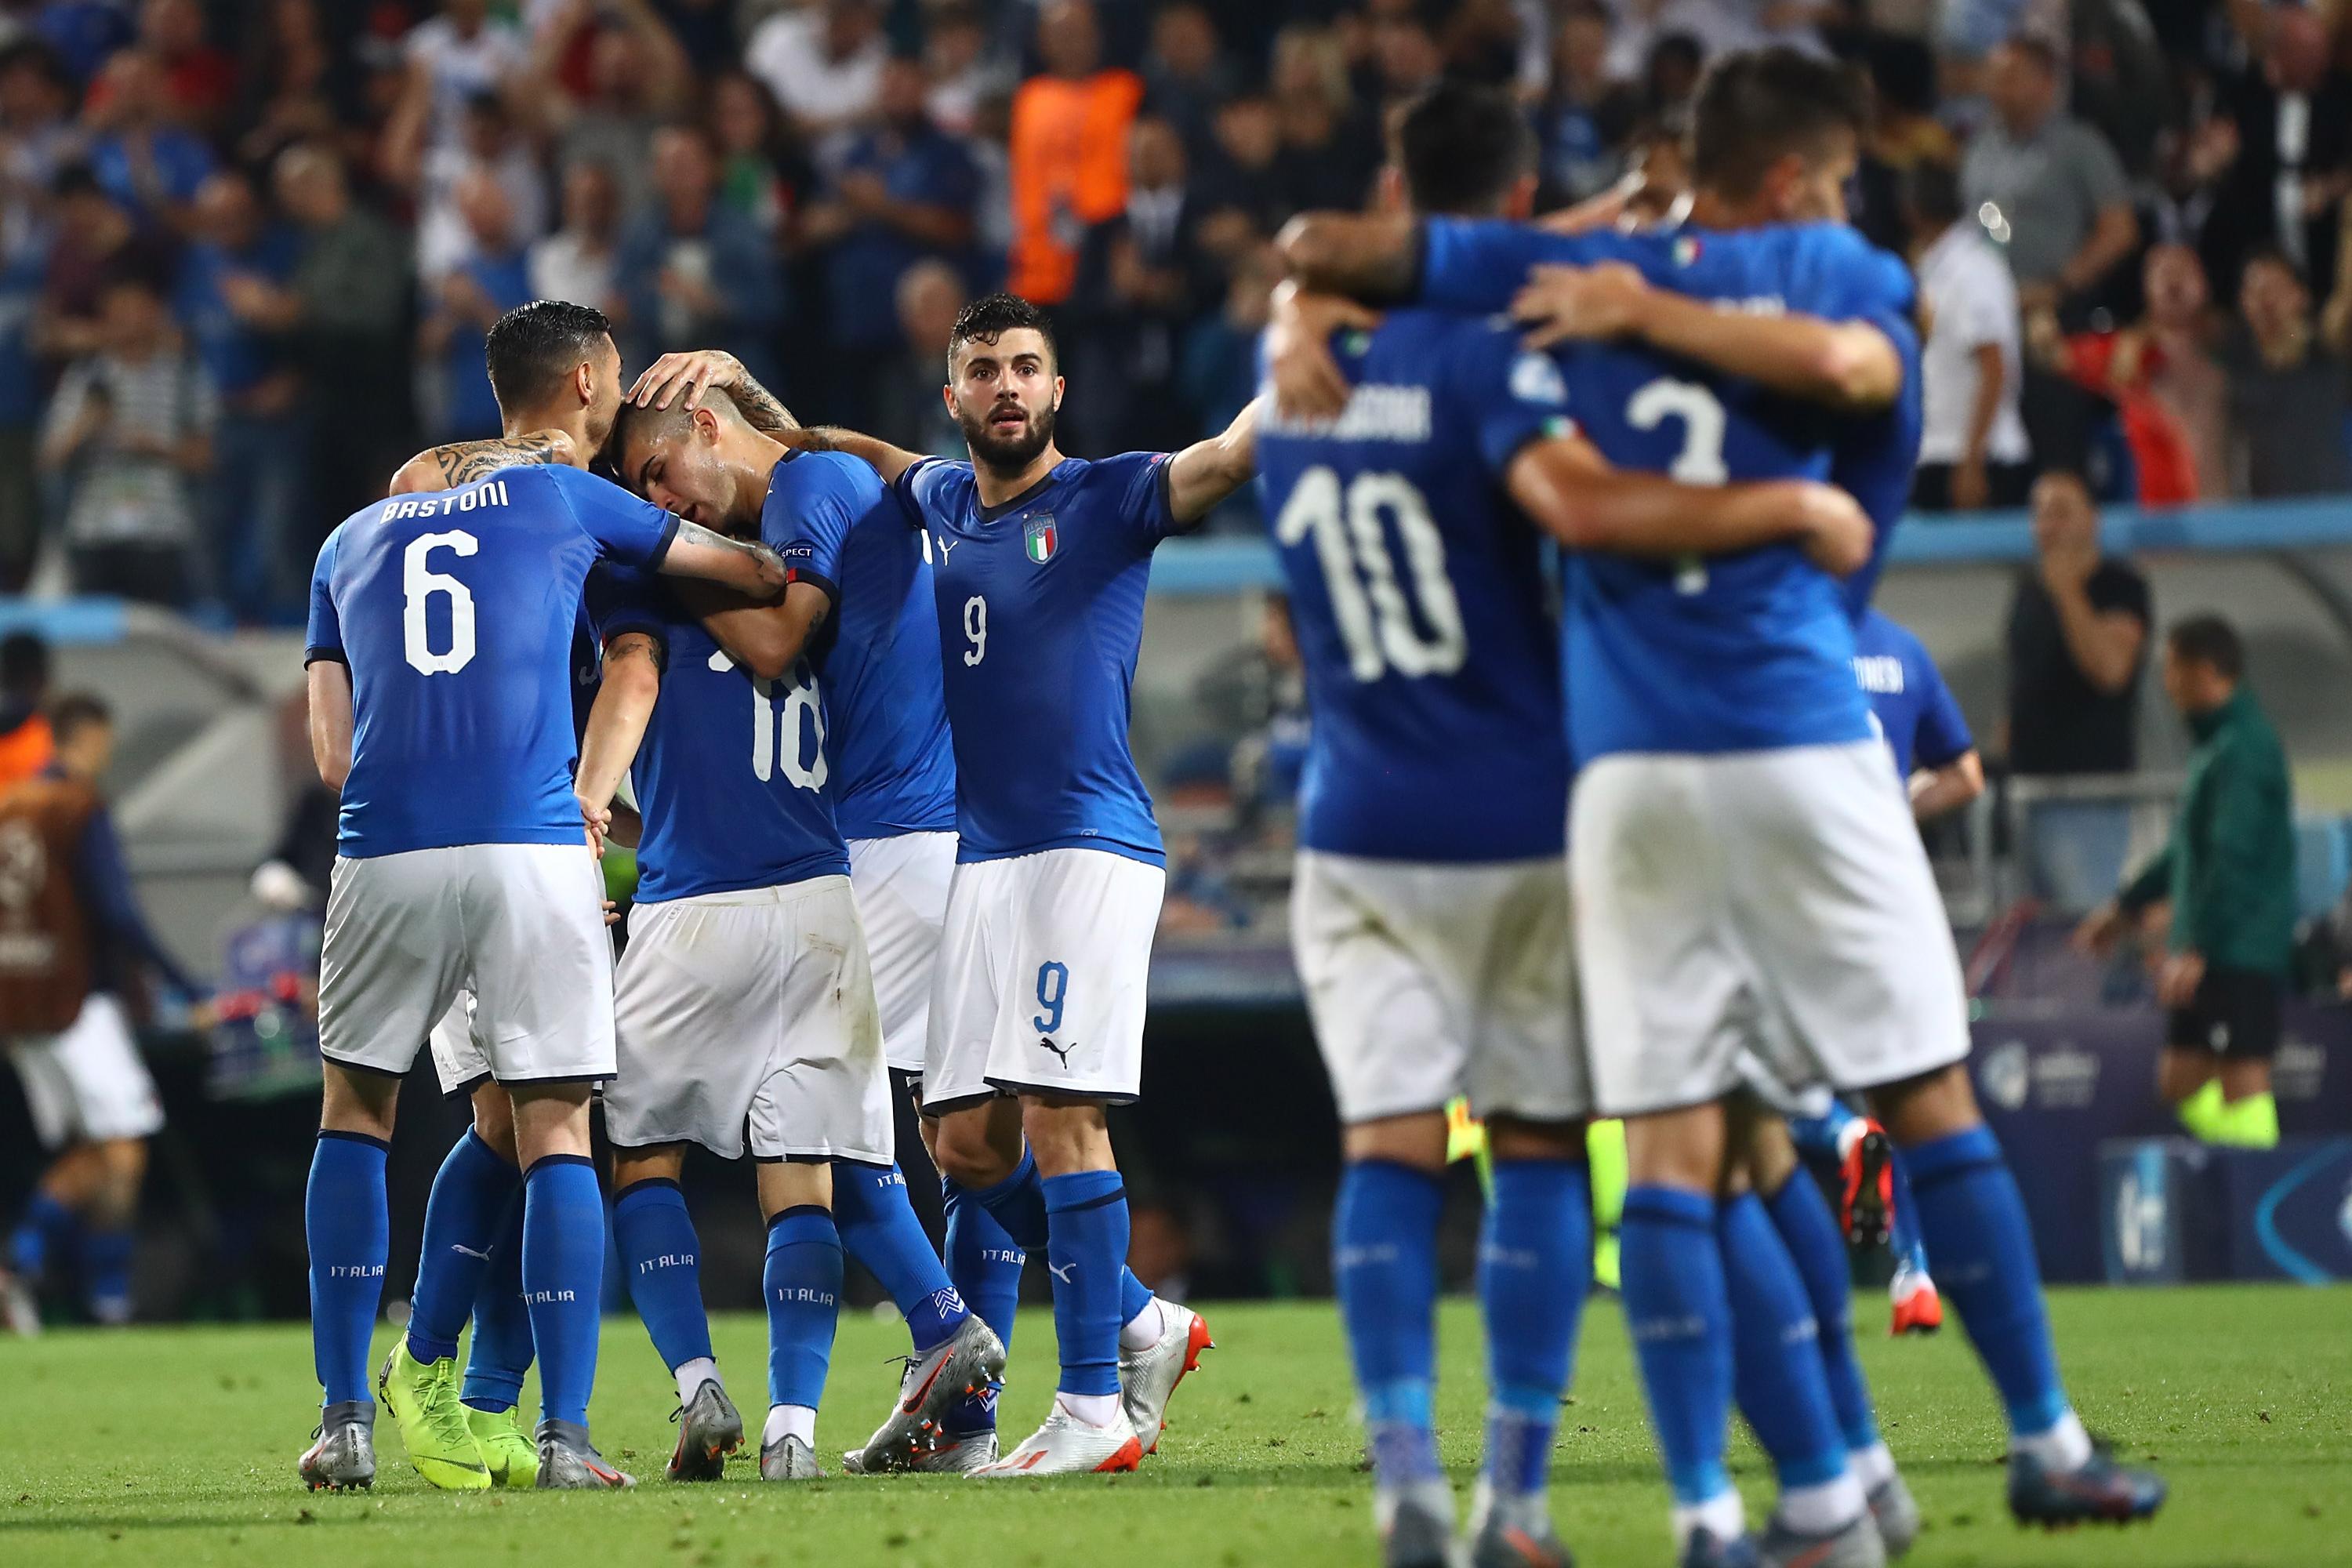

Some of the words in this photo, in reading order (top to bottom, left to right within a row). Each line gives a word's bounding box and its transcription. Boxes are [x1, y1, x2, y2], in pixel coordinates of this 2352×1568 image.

[379, 481, 509, 524] BASTONI
[1276, 464, 1468, 682] 10
[404, 529, 479, 676] 6
[964, 595, 987, 667] 9
[1033, 960, 1069, 1034] 9
[331, 1265, 384, 1278] ITALIA
[640, 1254, 694, 1275] ITALIA
[982, 1250, 1026, 1267] ITALIA
[779, 1288, 834, 1307] ITALIA
